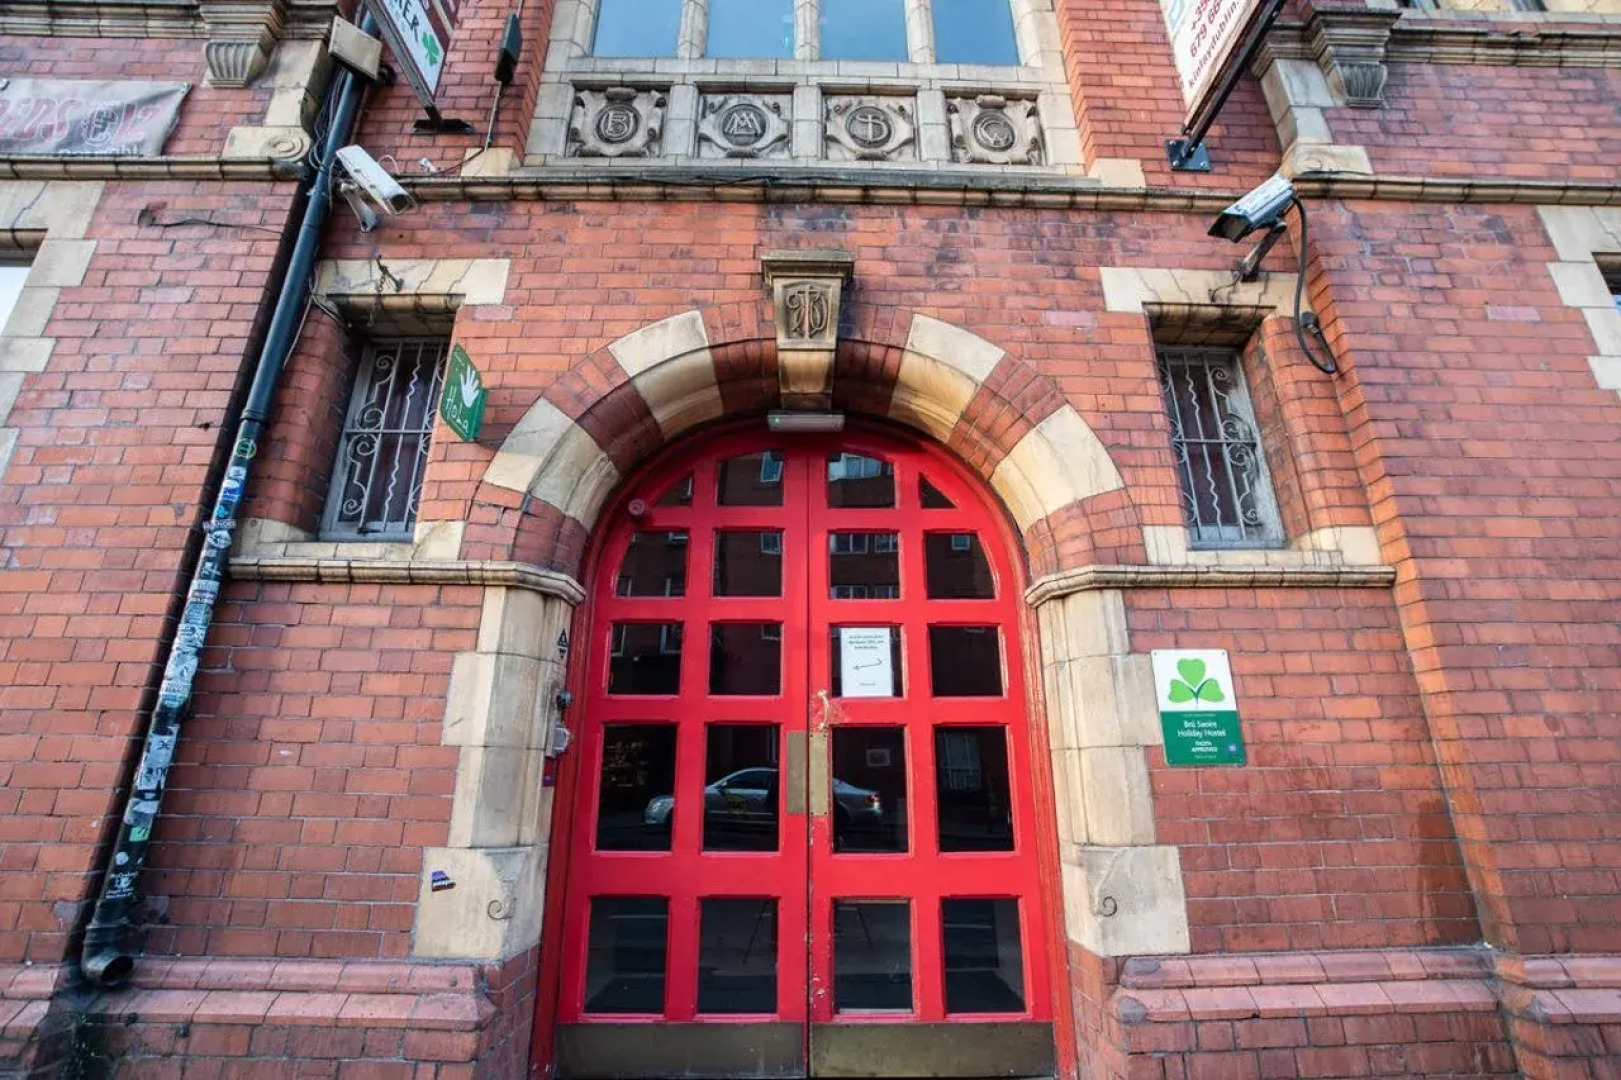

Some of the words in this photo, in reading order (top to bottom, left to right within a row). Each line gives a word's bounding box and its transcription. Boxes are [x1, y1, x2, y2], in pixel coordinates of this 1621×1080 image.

[1190, 23, 1207, 58] 679
[1177, 729, 1203, 739] Holiday
[1203, 728, 1227, 737] Hostel
